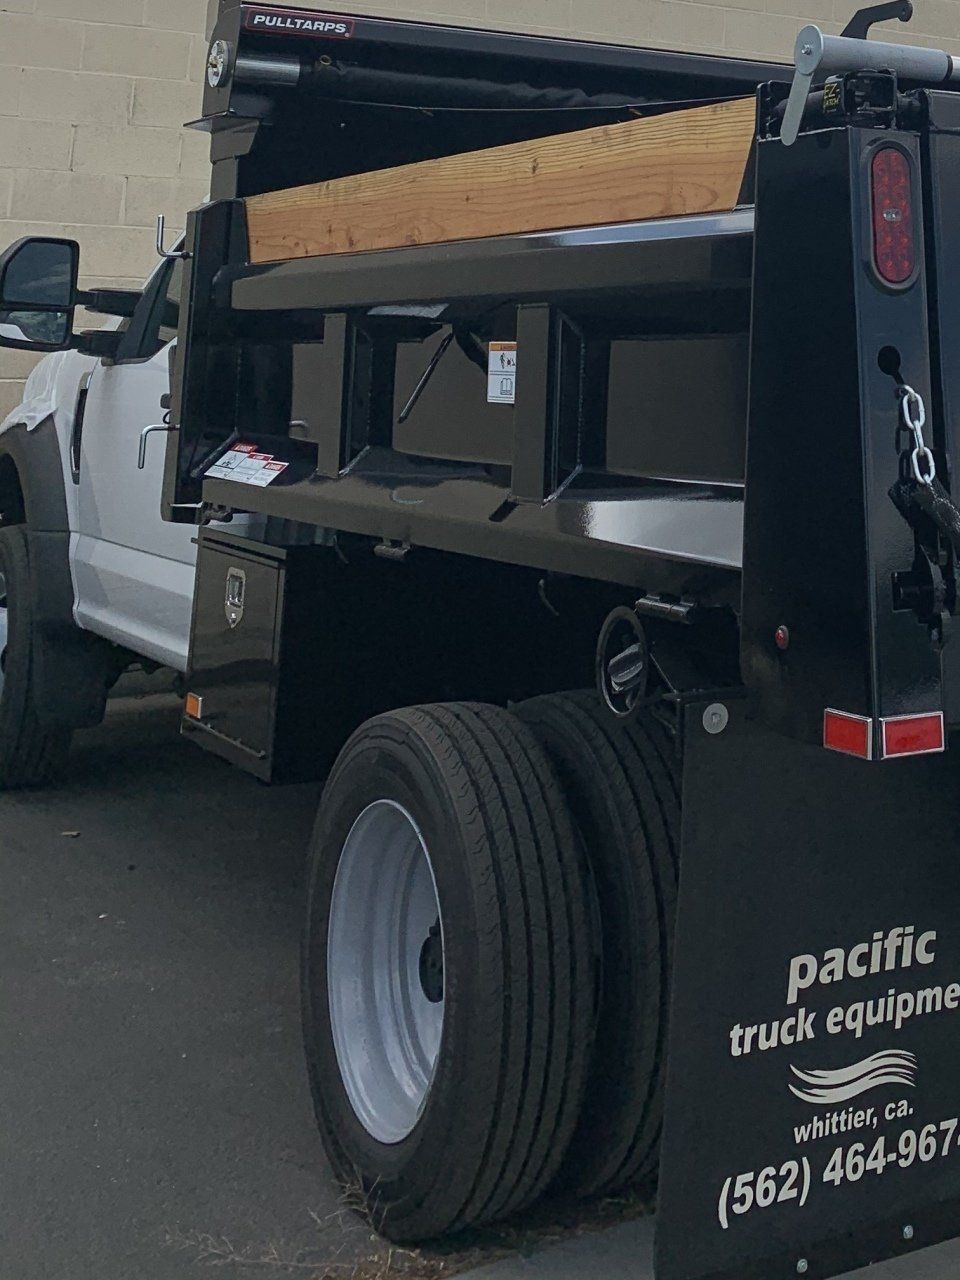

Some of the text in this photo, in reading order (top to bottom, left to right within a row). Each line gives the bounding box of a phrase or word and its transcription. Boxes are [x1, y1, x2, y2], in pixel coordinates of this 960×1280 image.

[253, 14, 347, 33] PULLTARPS
[786, 925, 937, 1005] pacific
[729, 1007, 817, 1057] truck
[793, 1099, 914, 1144] whittier, ca.
[717, 1156, 811, 1229] (562)
